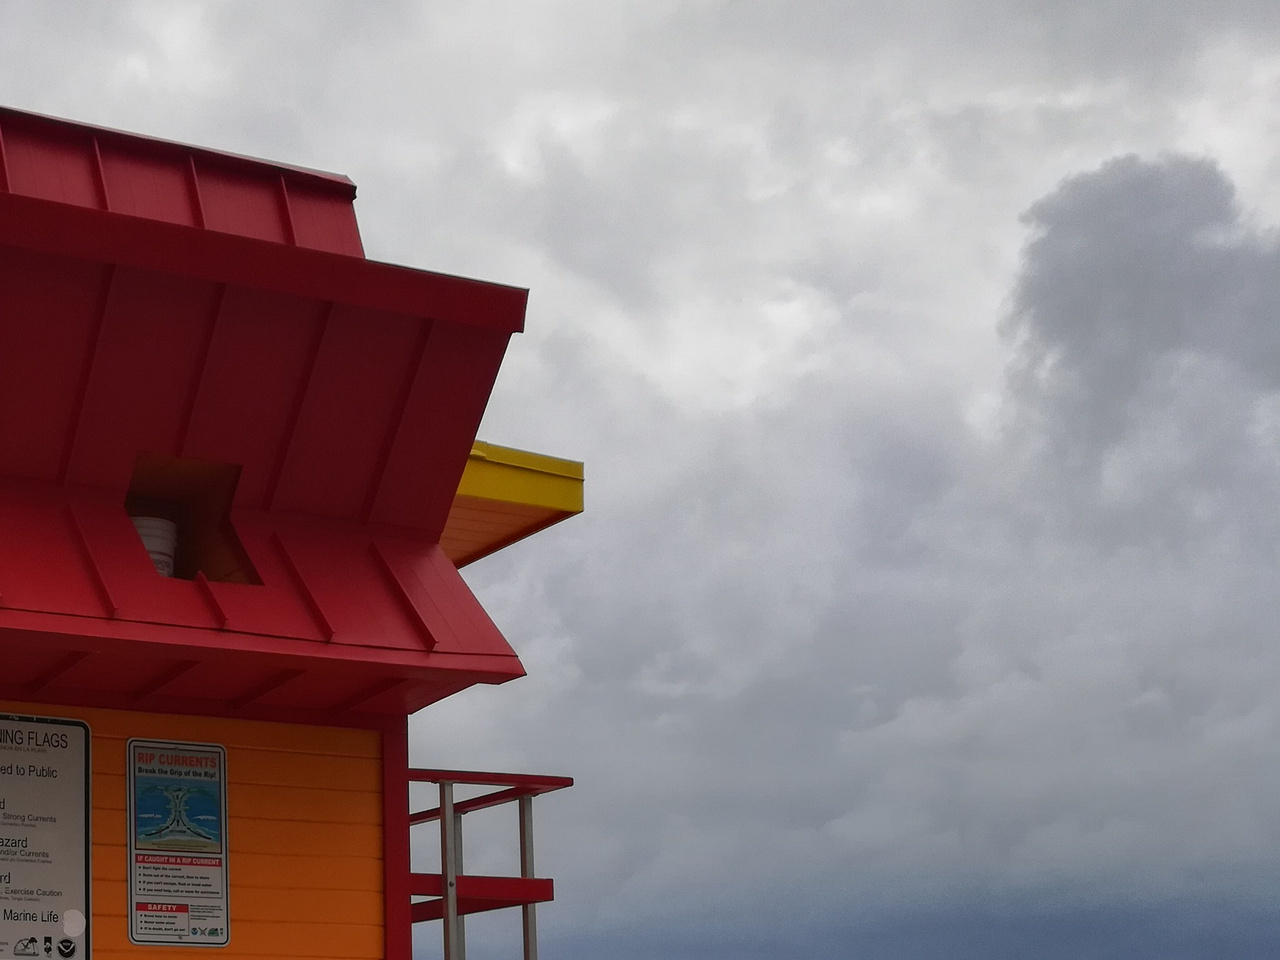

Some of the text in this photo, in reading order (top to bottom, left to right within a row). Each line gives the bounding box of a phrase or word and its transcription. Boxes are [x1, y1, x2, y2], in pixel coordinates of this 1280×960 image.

[27, 731, 68, 748] FLAGS
[138, 752, 217, 769] RIP CURRENTS
[16, 765, 25, 776] to
[29, 765, 58, 779] Public
[137, 766, 157, 774] Break
[169, 768, 183, 777] Grip
[203, 771, 216, 779] Rip!
[2, 813, 26, 822] Strong
[27, 814, 57, 823] Currents
[19, 850, 50, 858] Currents
[36, 889, 63, 897] Caution
[3, 908, 38, 922] Marine
[41, 910, 59, 923] Life
